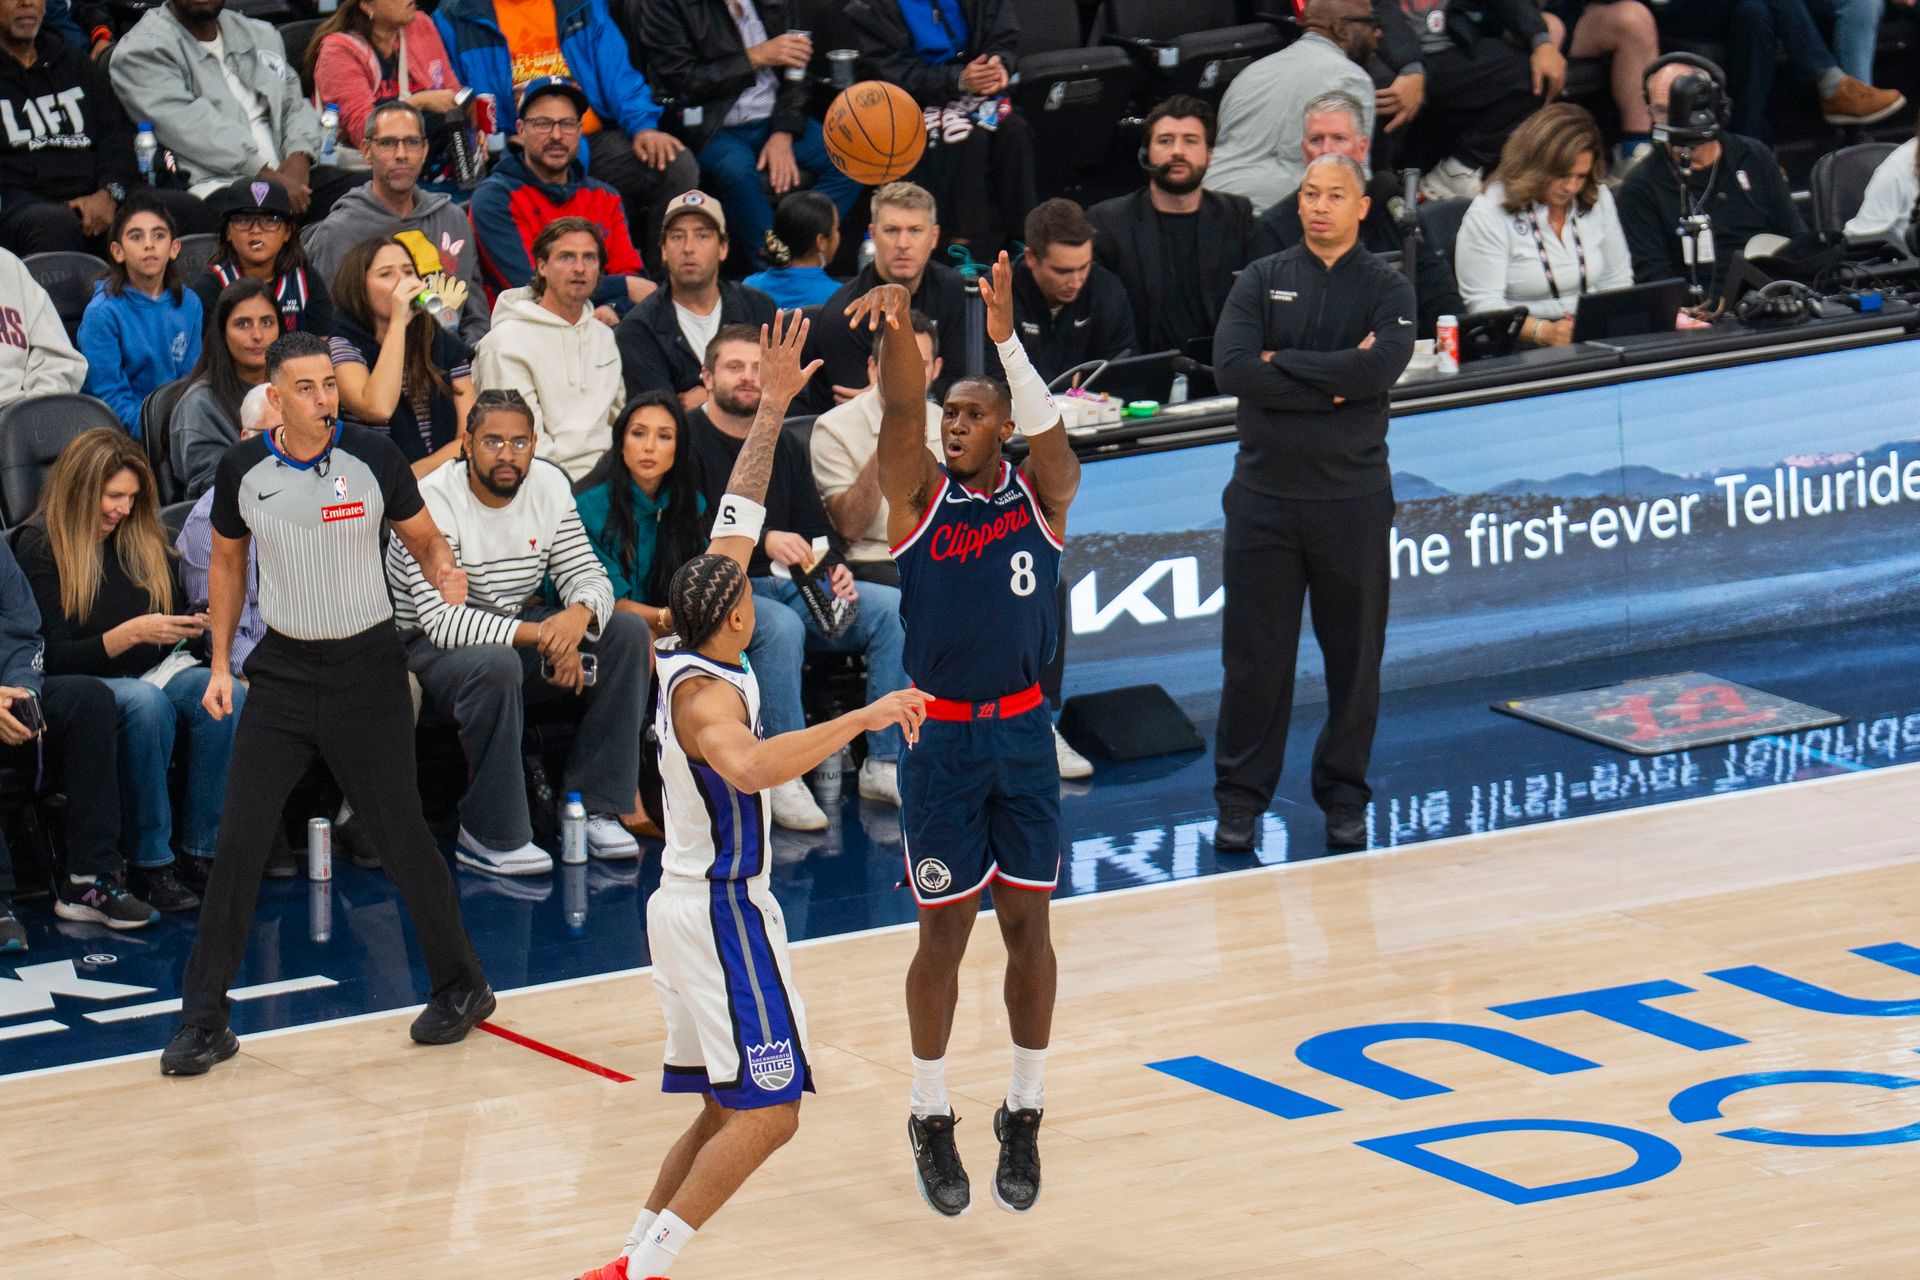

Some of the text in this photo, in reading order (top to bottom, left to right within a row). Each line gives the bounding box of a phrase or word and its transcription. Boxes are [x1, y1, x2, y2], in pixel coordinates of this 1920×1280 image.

[322, 505, 364, 520] Emirates
[930, 504, 1031, 563] Clippers
[1390, 450, 1920, 579] he first-ever Telluride
[1010, 551, 1036, 596] 8
[1070, 555, 1225, 636] KI
[752, 1060, 792, 1074] KINGS
